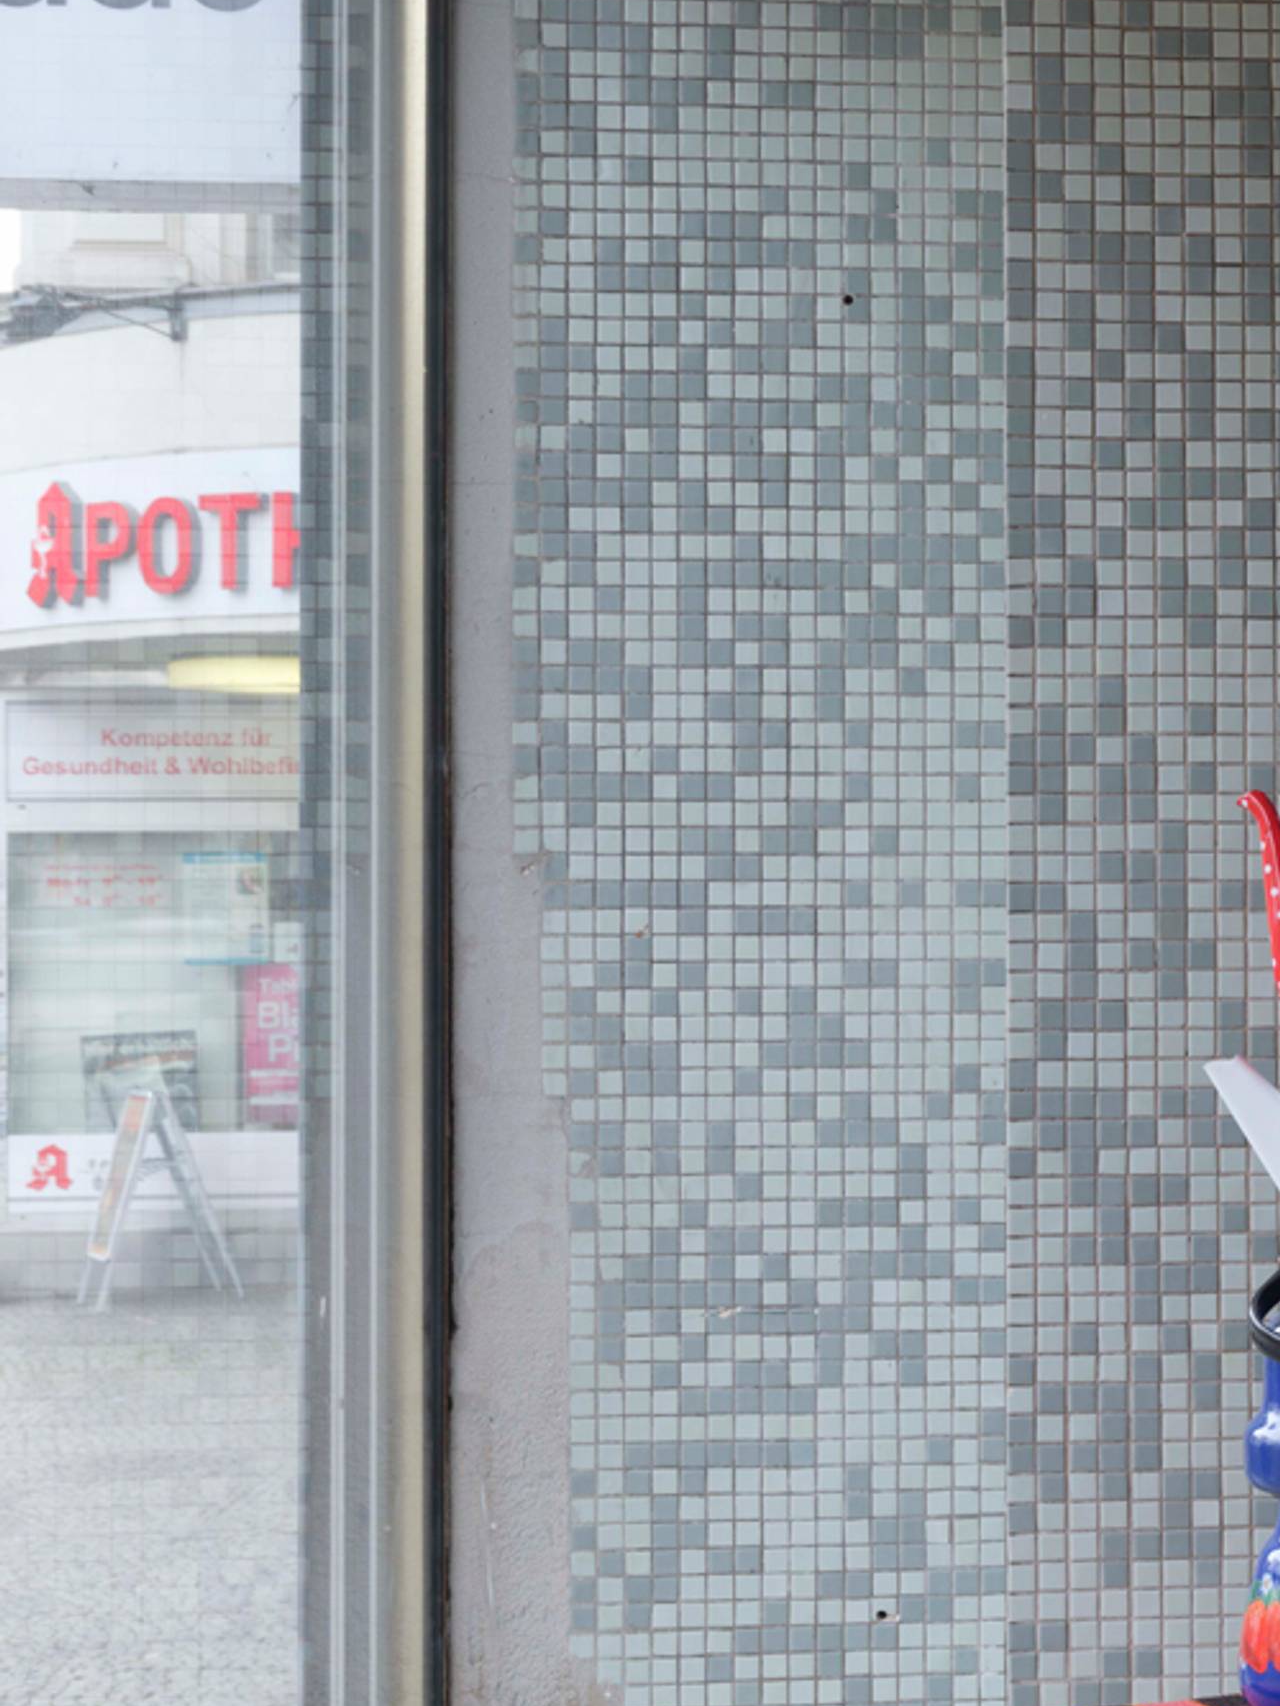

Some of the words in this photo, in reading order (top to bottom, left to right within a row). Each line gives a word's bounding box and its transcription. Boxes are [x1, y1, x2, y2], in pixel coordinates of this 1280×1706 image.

[100, 727, 233, 749] Kompetenz
[240, 726, 271, 747] für
[22, 756, 158, 775] Gesundheit
[164, 755, 181, 775] &
